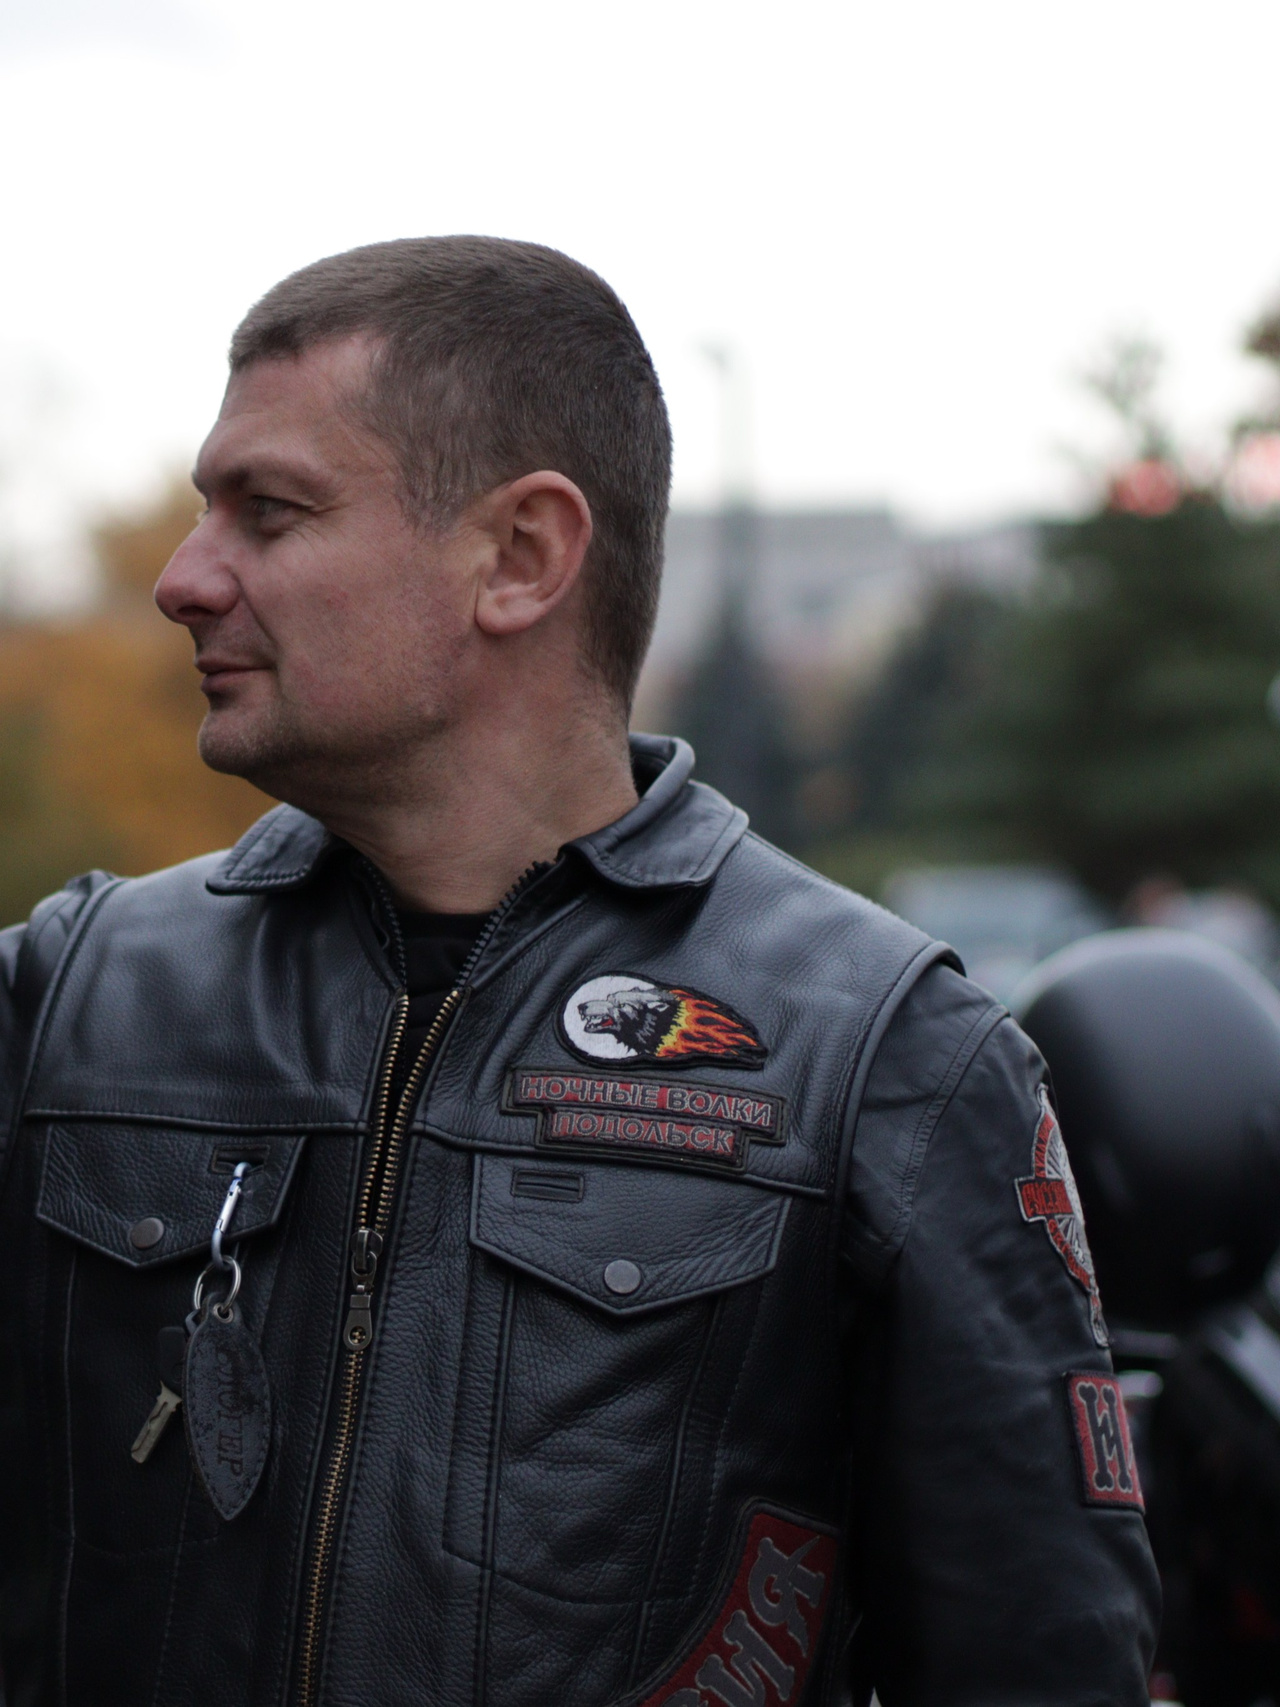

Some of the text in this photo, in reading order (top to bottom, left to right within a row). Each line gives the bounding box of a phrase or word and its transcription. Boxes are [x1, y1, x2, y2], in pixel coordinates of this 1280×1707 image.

[521, 1076, 772, 1127] НОЧНЫЕ ВОЛКИ
[552, 1111, 733, 1153] ПОДОЛЬСК
[661, 1535, 825, 1707] ИЯ
